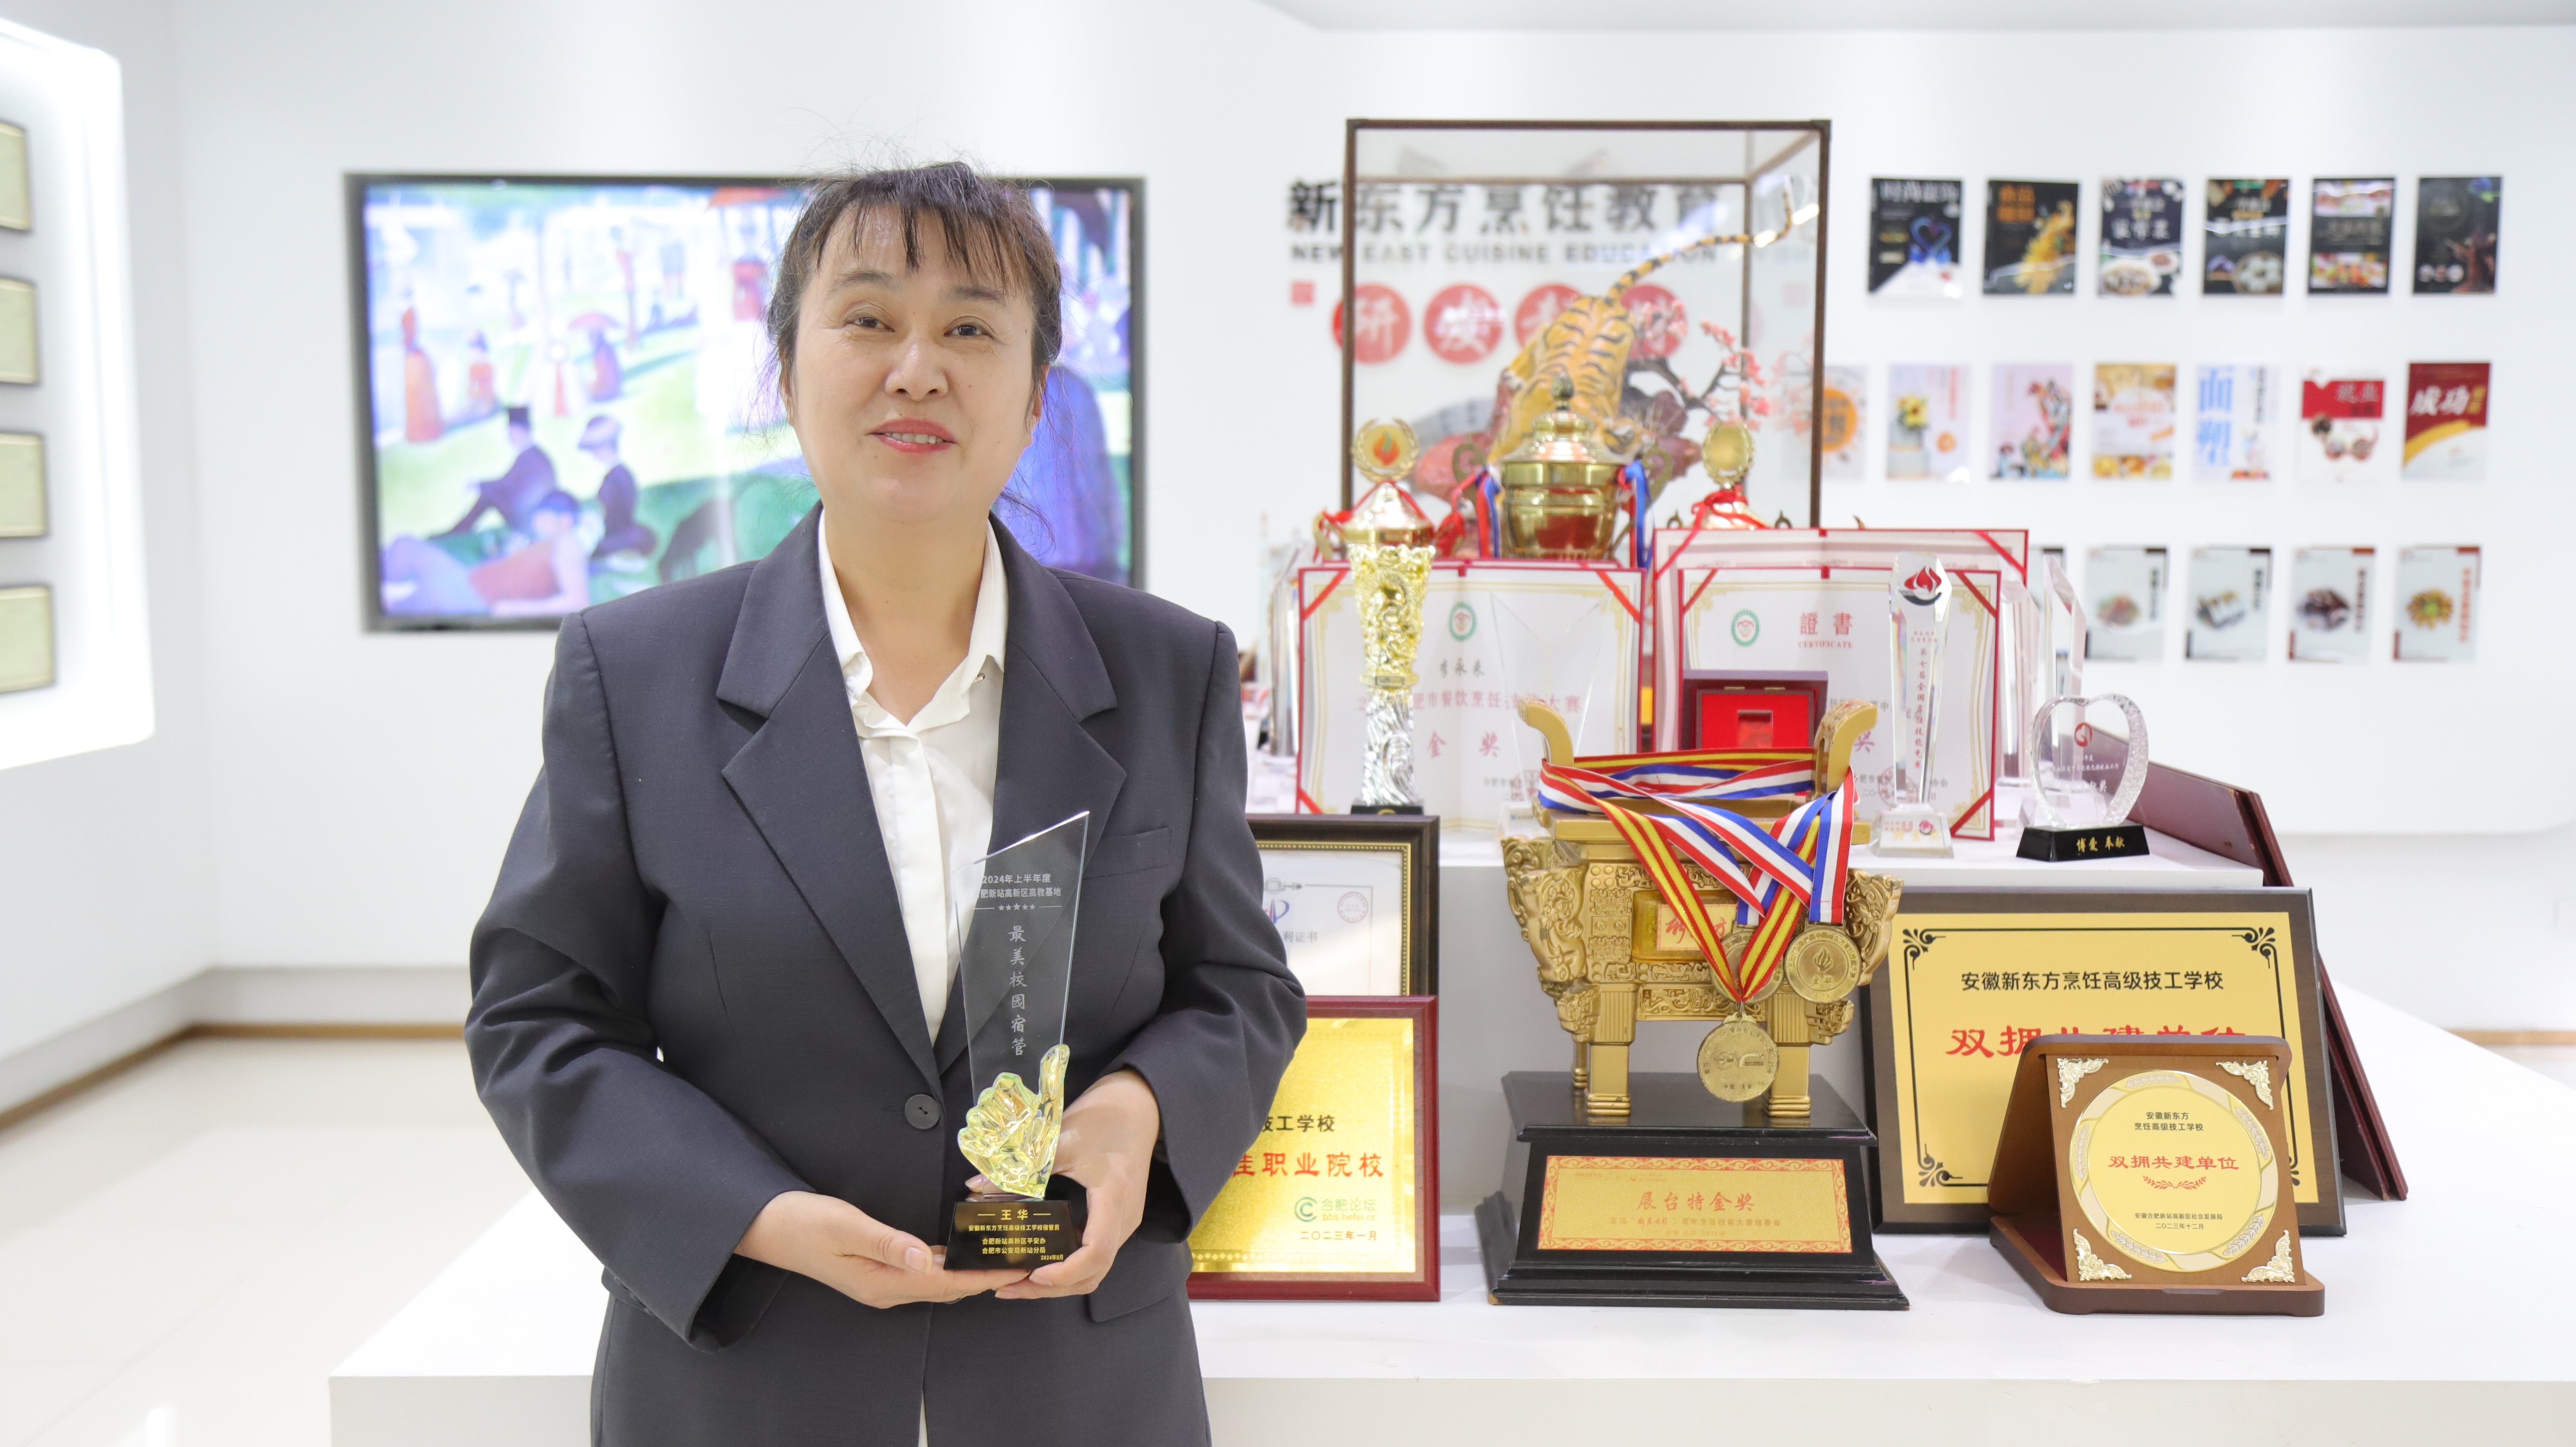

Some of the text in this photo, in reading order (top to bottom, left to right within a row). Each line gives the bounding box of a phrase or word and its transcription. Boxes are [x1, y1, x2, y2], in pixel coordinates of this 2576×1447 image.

[1364, 244, 1430, 263] EAST
[1444, 244, 1550, 263] CUISINE
[2409, 384, 2470, 416] 成功
[1798, 640, 1854, 649] CERTIFICATE
[1427, 730, 1501, 759] 金奖
[983, 873, 1051, 884] 2024年上半年度
[973, 887, 1062, 899] 合肥新站高新区高教基地
[1960, 970, 2224, 992] 安徽新东方烹饪高级技工学校
[1008, 925, 1027, 1056] 最美校园宿管
[2146, 1111, 2189, 1120] 安徽新东方
[2134, 1122, 2204, 1132] 烹饪高级技工学校
[2107, 1155, 2240, 1170] 双拥共建单位
[1321, 1198, 1376, 1212] 合肥论坛
[1636, 1191, 1754, 1212] 展台特金奖
[1001, 1209, 1029, 1221] 王华
[2134, 1212, 2223, 1221] 安徽合肥新站高新区社会发展局
[982, 1237, 1046, 1245] 合肥新站高新区平安办
